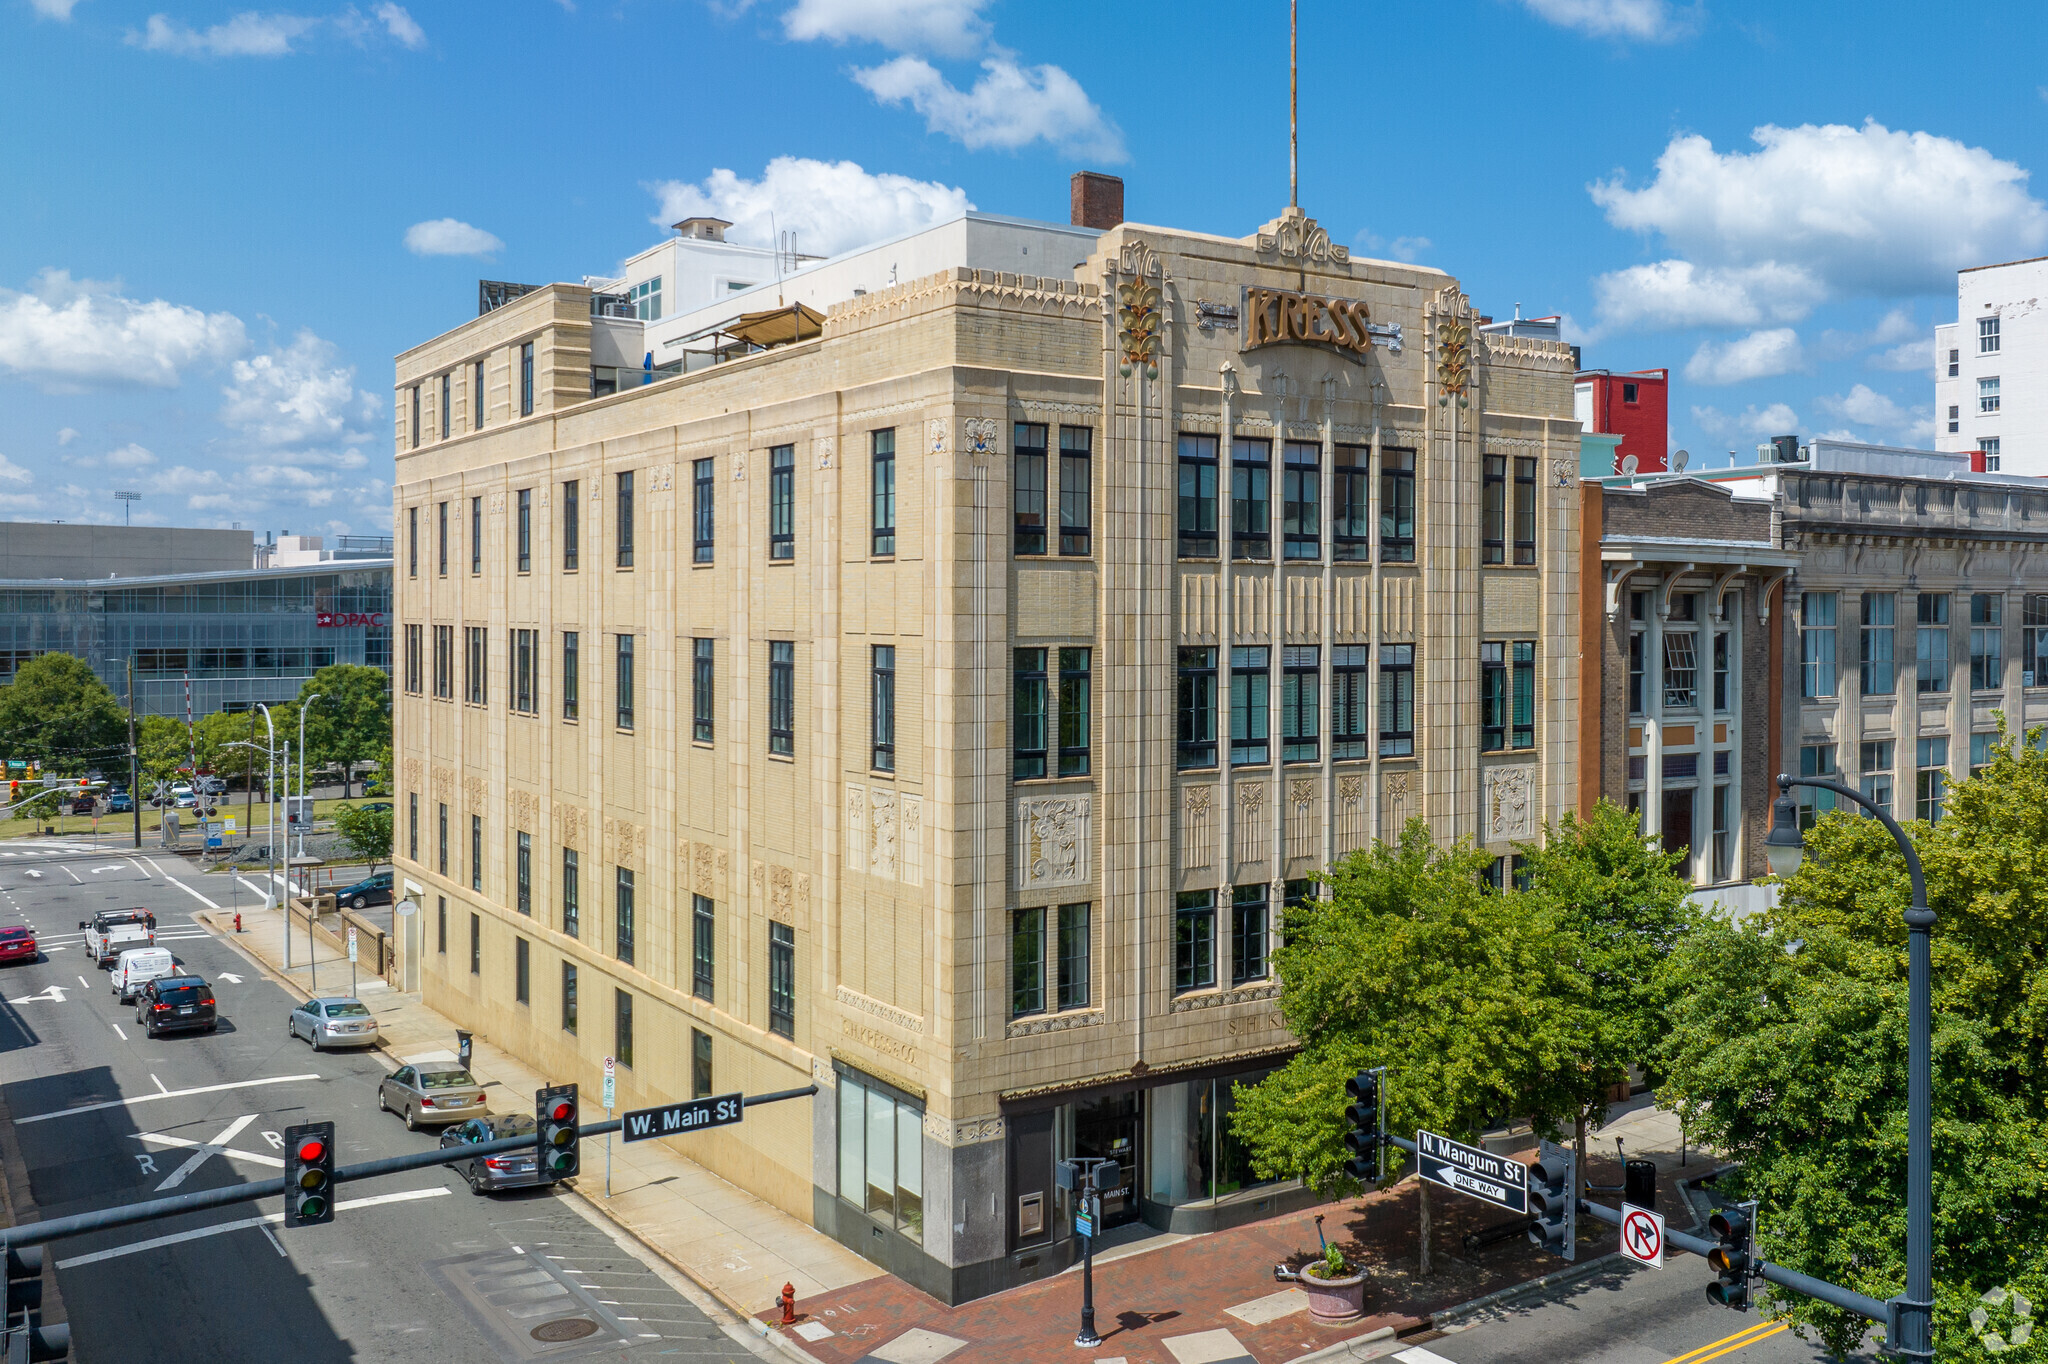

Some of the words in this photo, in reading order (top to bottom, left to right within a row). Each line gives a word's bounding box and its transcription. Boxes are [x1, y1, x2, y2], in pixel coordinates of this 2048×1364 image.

[1246, 288, 1372, 353] KRESS
[334, 613, 384, 627] DPAC
[663, 1106, 710, 1130] Main
[716, 1100, 738, 1120] St
[1109, 1146, 1132, 1155] STEWART
[1423, 1134, 1435, 1153] N.
[1438, 1139, 1499, 1175] Mangum
[1504, 1161, 1521, 1182] St
[134, 1154, 159, 1175] R
[1103, 1190, 1121, 1199] MAIN
[1121, 1187, 1130, 1196] ST.
[1455, 1174, 1475, 1188] ONE
[1478, 1182, 1499, 1197] WAY
